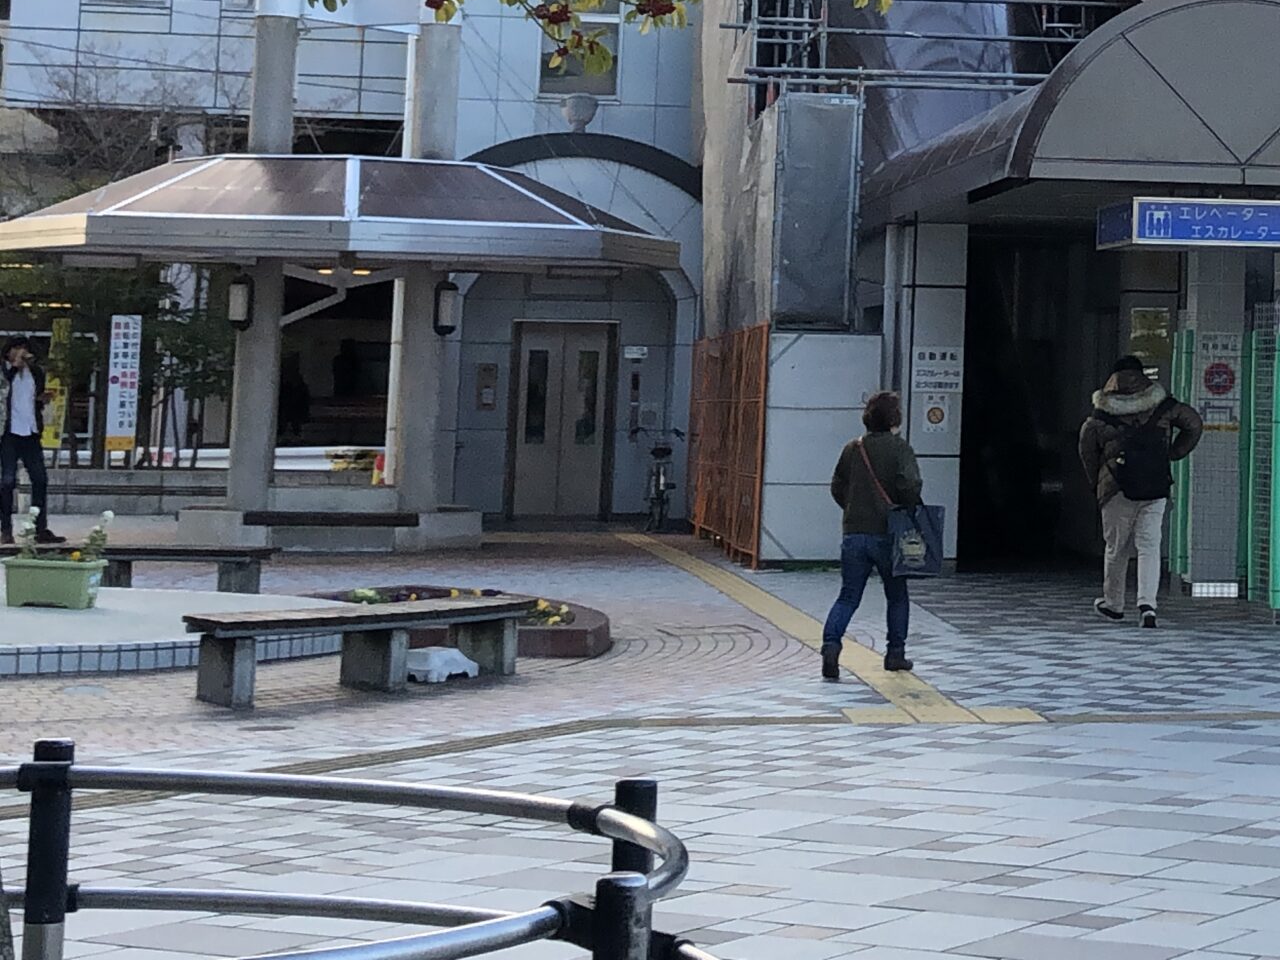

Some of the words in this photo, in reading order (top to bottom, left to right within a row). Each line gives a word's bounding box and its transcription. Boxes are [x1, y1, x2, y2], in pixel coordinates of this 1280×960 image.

[1179, 206, 1268, 221] エレベーター
[1191, 225, 1280, 239] エスカレーター
